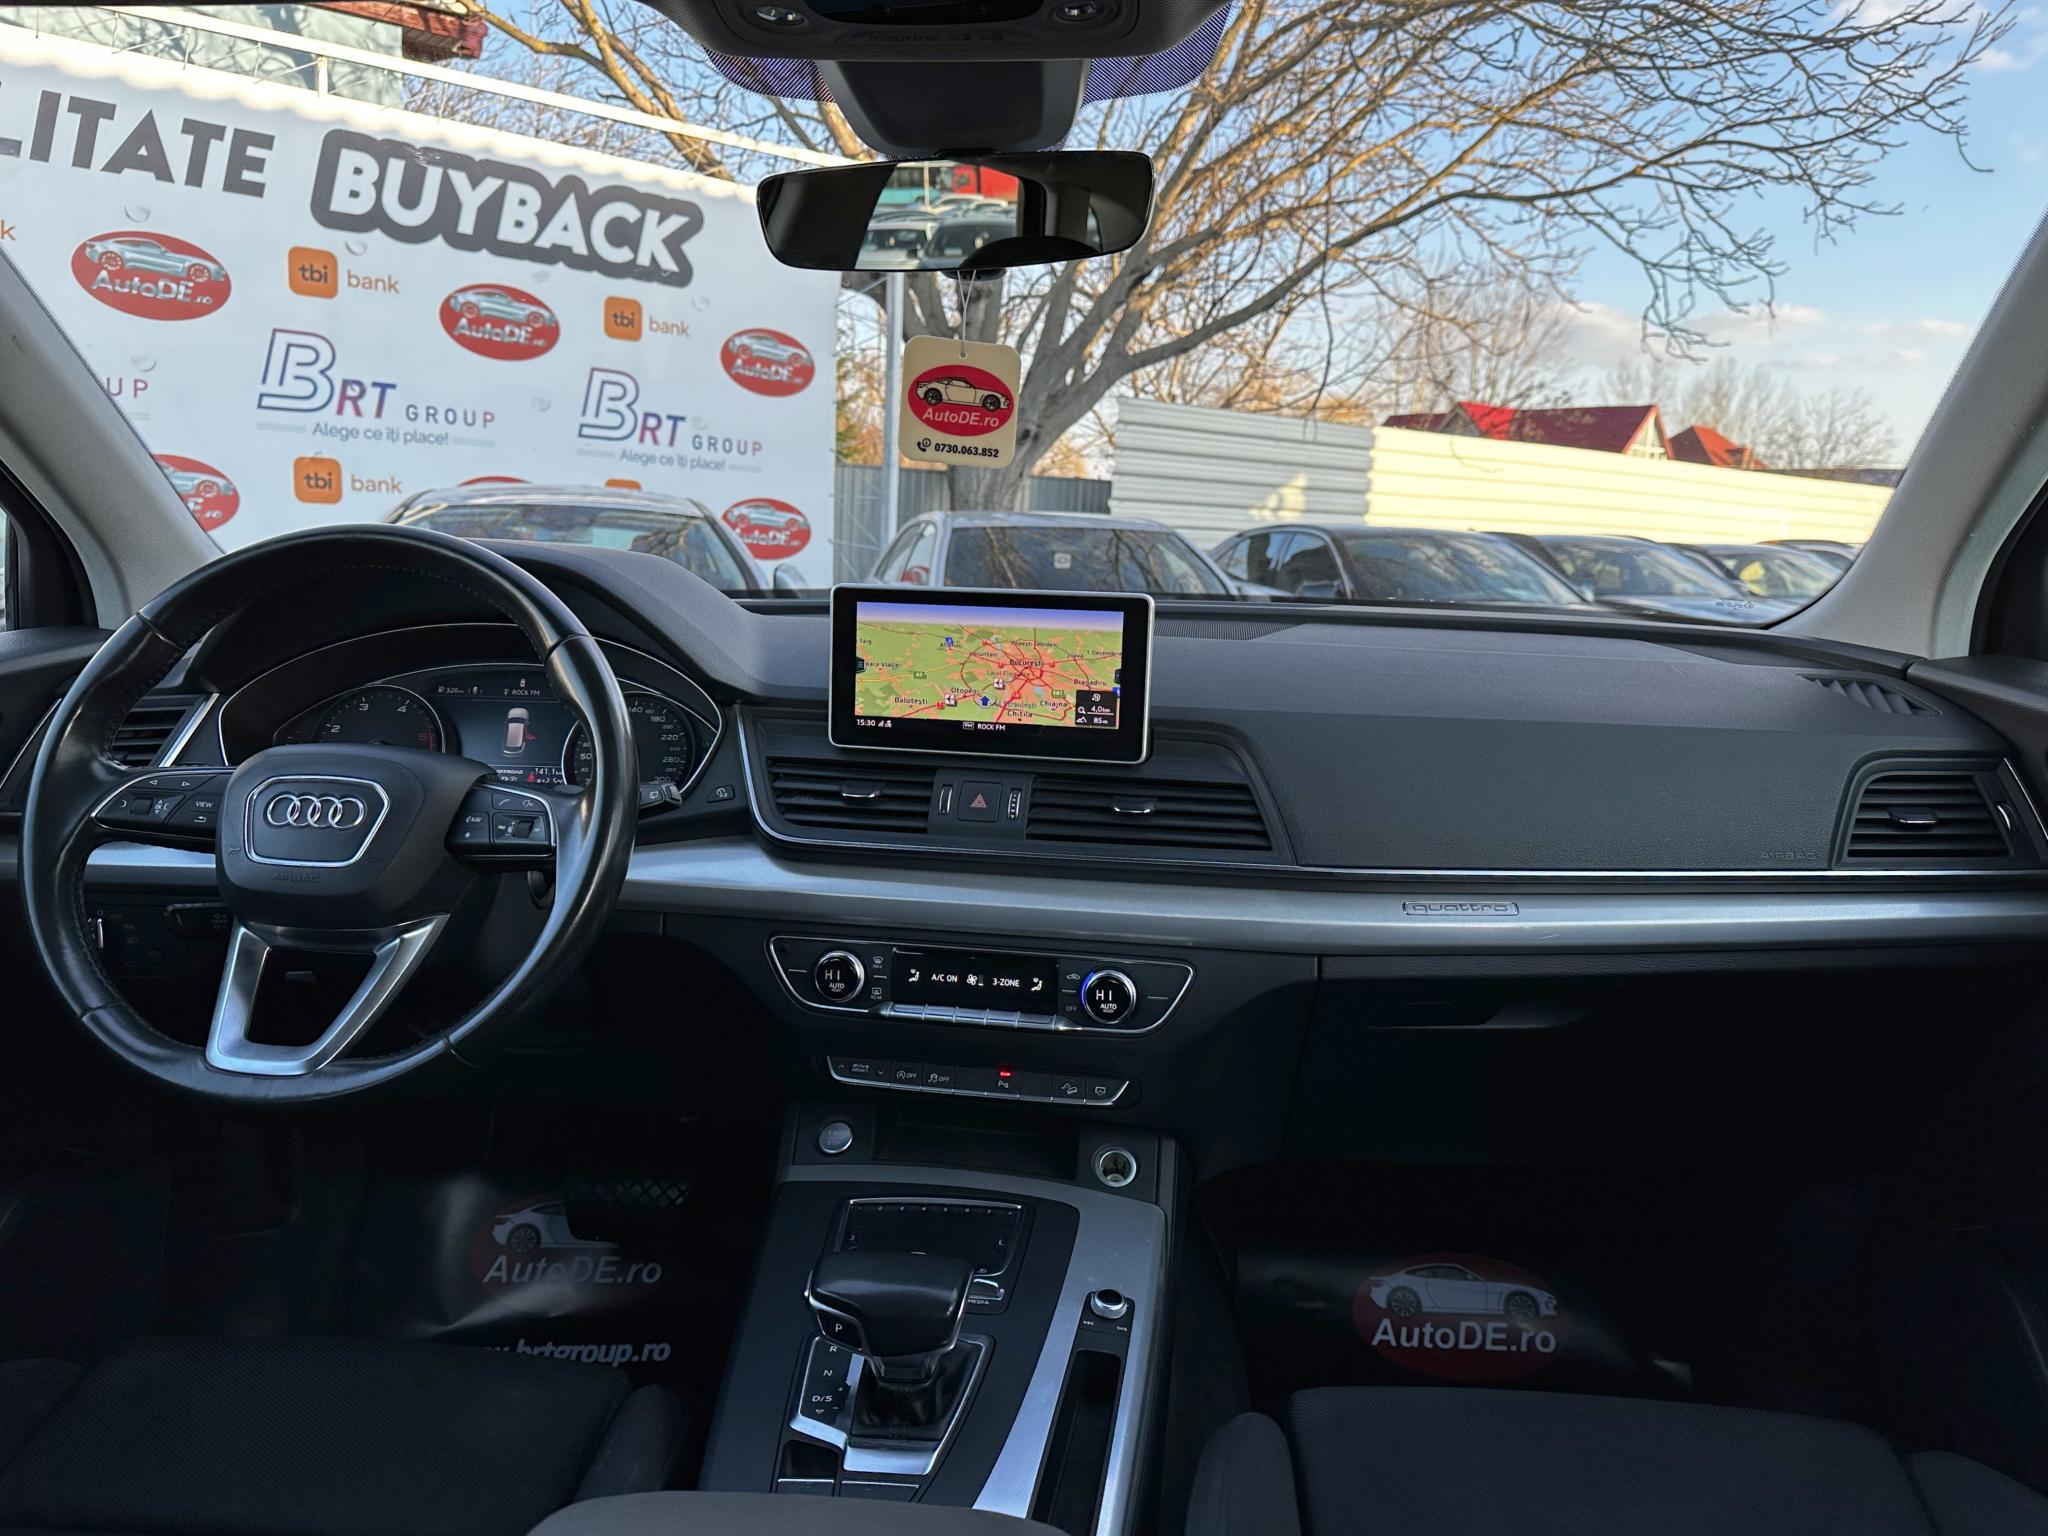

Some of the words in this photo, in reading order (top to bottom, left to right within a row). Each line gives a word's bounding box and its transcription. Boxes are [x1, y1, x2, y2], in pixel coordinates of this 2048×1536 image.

[329, 147, 691, 273] BUYBACK
[298, 264, 329, 285] tbi
[347, 269, 400, 294] bank
[612, 310, 635, 328] tbi
[650, 315, 690, 337] bank
[405, 404, 495, 428] GROUP
[922, 407, 999, 428] AutoDE.ro
[312, 422, 360, 442] Alege
[363, 428, 382, 441] ce
[403, 429, 448, 446] place!
[692, 434, 762, 457] GROUP
[935, 442, 999, 458] 0730.063.852
[620, 449, 657, 467] Alege
[659, 456, 675, 466] ce
[690, 457, 725, 471] place!
[304, 471, 333, 491] tbi
[350, 474, 402, 494] bank
[359, 703, 369, 711] 3
[397, 705, 407, 713] 4
[330, 724, 341, 733] 2
[857, 719, 876, 727] 15:30
[1412, 903, 1508, 914] quattro
[829, 982, 845, 990] AUTO
[931, 973, 945, 982] A/C
[946, 974, 958, 982] ON
[992, 977, 1020, 987] 3-ZONE
[835, 1322, 843, 1332] P
[1371, 1318, 1557, 1353] AutoDE.ro
